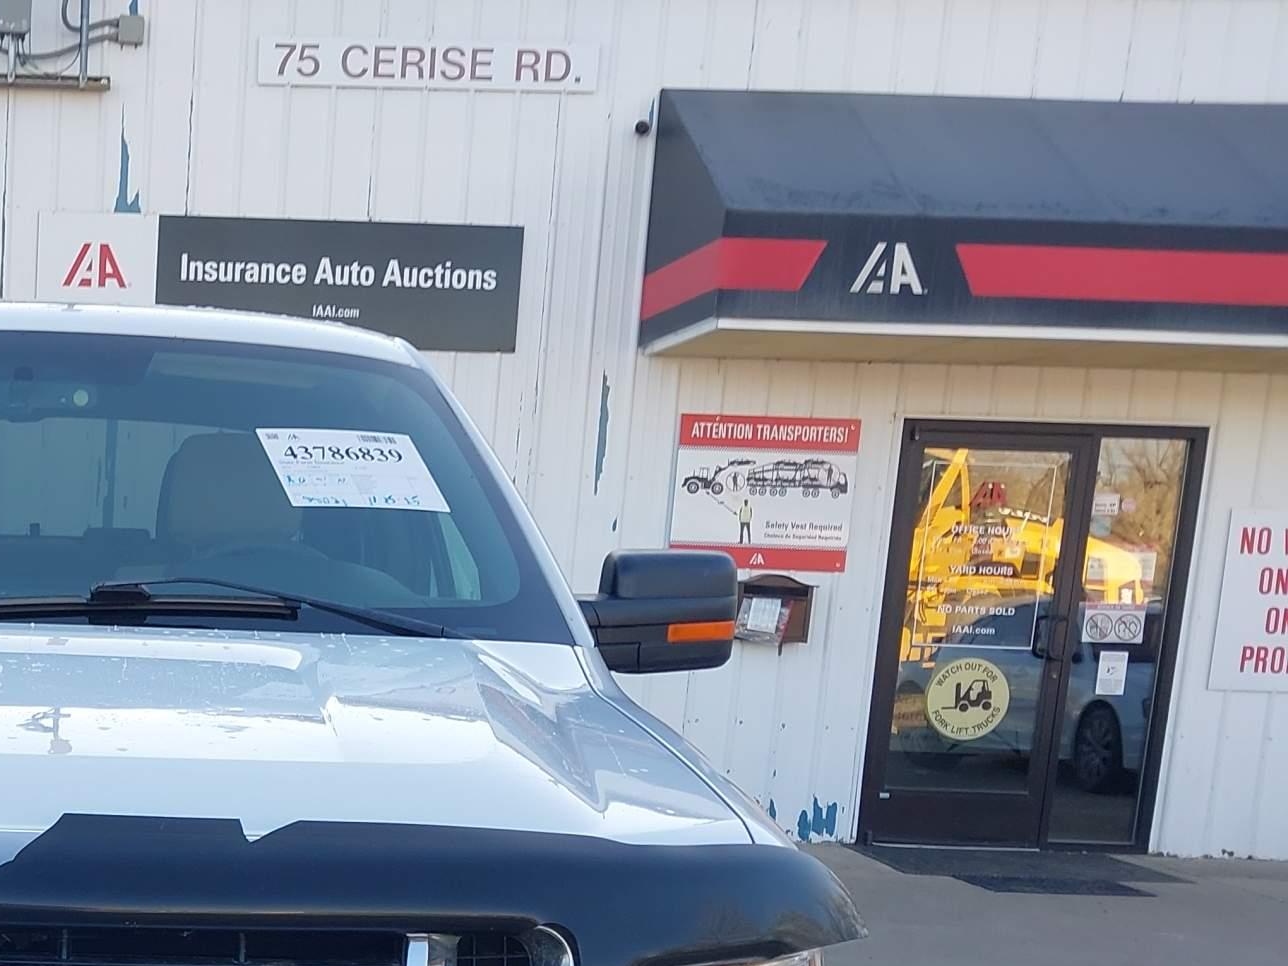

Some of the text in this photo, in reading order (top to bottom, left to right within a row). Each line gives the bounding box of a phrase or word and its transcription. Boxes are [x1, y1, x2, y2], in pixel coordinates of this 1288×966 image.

[274, 43, 581, 84] 75 CERISE RD.
[180, 253, 498, 291] Insurance Auto Auctions
[312, 304, 360, 320] IAAI.com
[691, 421, 849, 443] ATTENTION TRANSPORTERS!
[283, 445, 403, 463] 43786839
[765, 521, 843, 533] Safety Vest Required
[952, 524, 985, 536] OFFICE
[1239, 527, 1272, 555] NO
[950, 565, 1014, 576] YARD HOURS
[937, 604, 1015, 616] NO PARTS SOLD
[952, 625, 995, 635] IAAI.com
[1239, 646, 1288, 673] PRO
[936, 662, 999, 687] WATCH OUT FOR
[932, 706, 1001, 735] FORK LIFT TRUCKS
